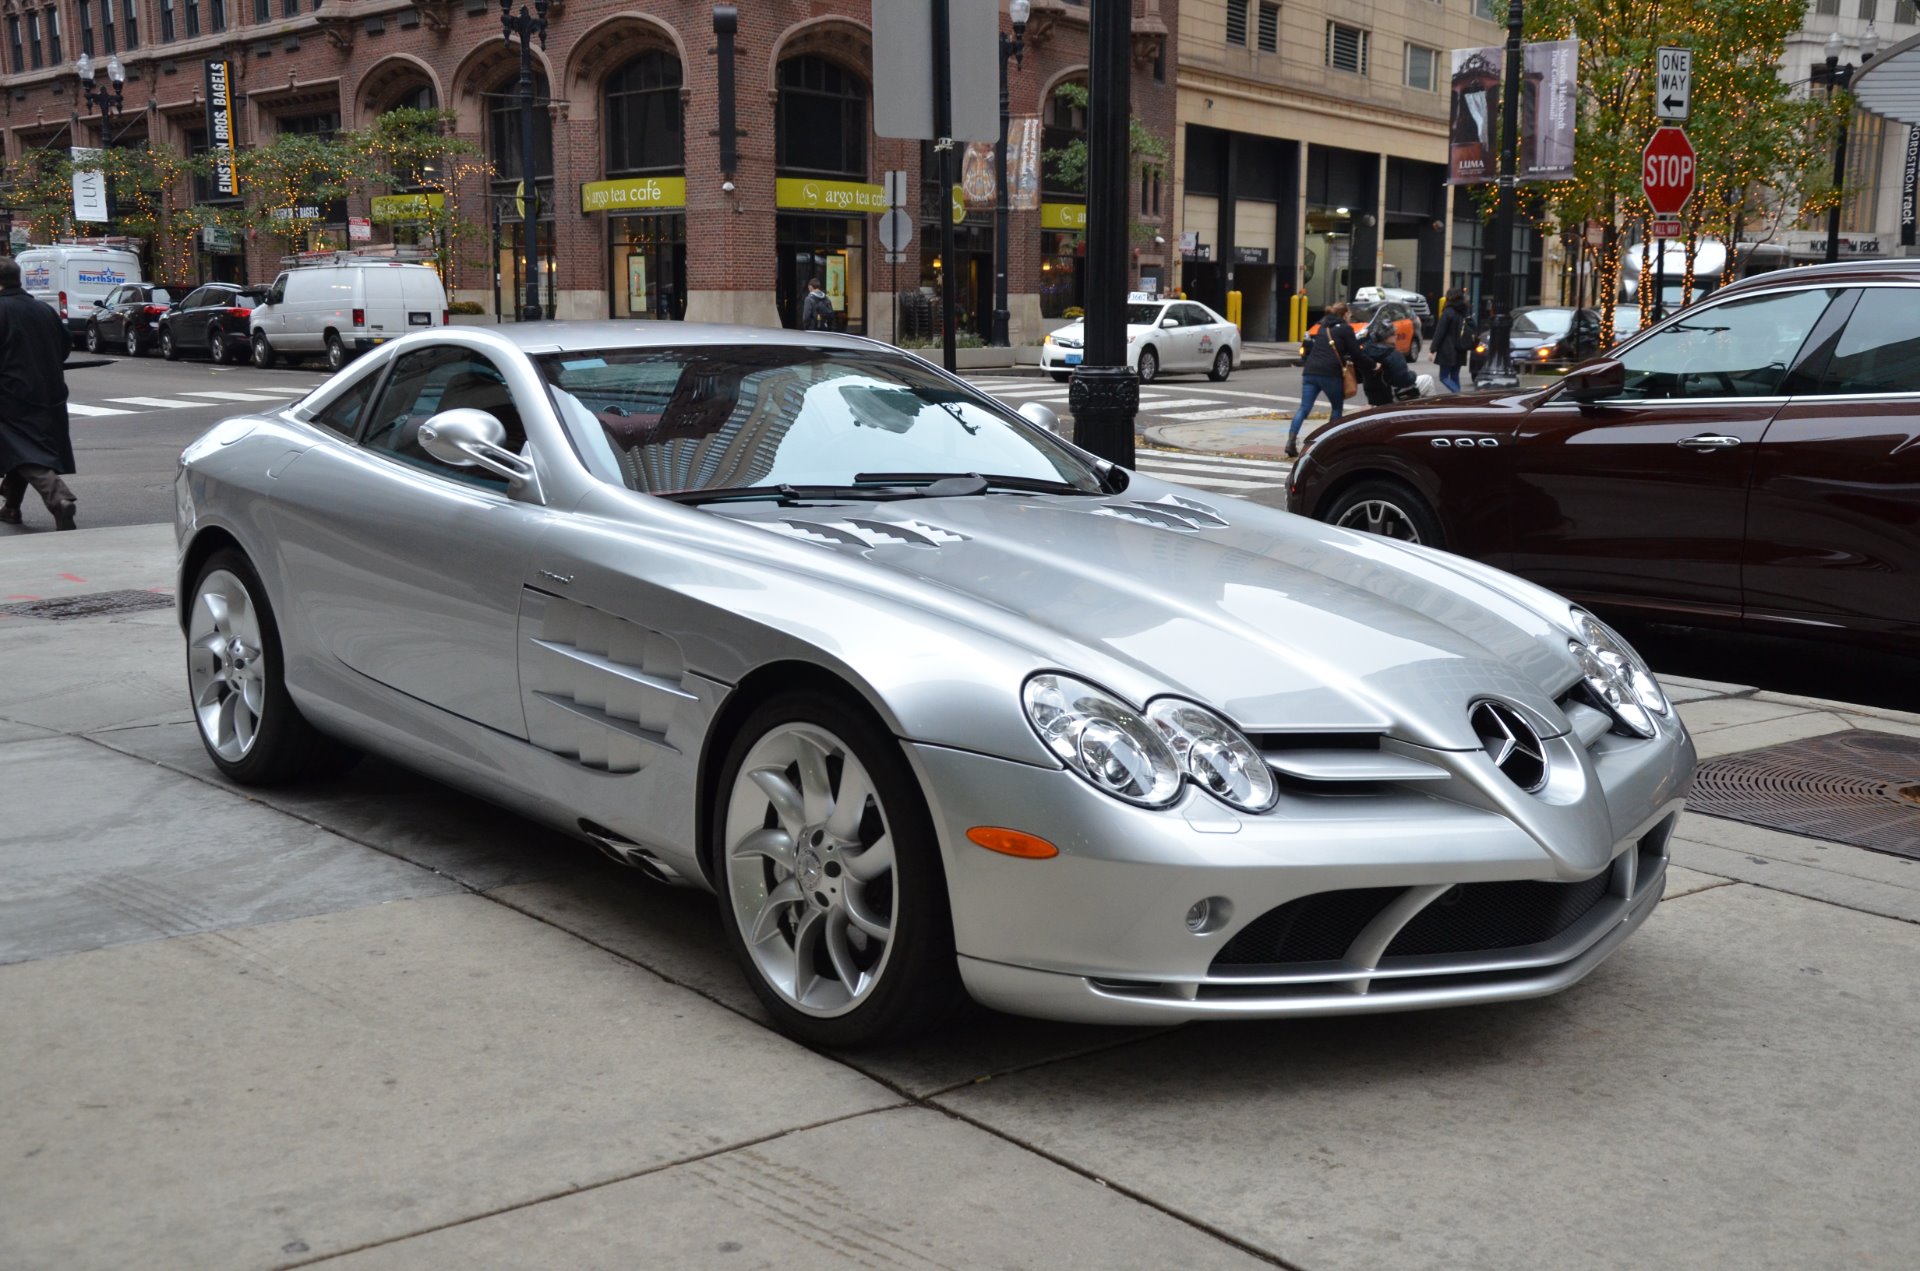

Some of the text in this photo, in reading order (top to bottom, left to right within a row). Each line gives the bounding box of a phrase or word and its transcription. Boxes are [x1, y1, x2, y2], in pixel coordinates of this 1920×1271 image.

[1550, 49, 1559, 67] True
[1559, 48, 1569, 84] Marcella
[1662, 55, 1687, 72] ONE
[1661, 74, 1687, 90] WAY
[210, 63, 233, 193] EINSTN BROS. BAGELS
[1459, 160, 1484, 168] LUMA
[1646, 154, 1692, 187] STOP
[592, 179, 661, 208] argo tea café
[825, 189, 853, 208] argo
[856, 189, 870, 204] tea
[300, 206, 319, 218] BAGELS
[1902, 196, 1915, 225] rack
[1655, 223, 1679, 234] ALL WAY
[1860, 237, 1879, 252] rack
[80, 275, 125, 283] NorthStar
